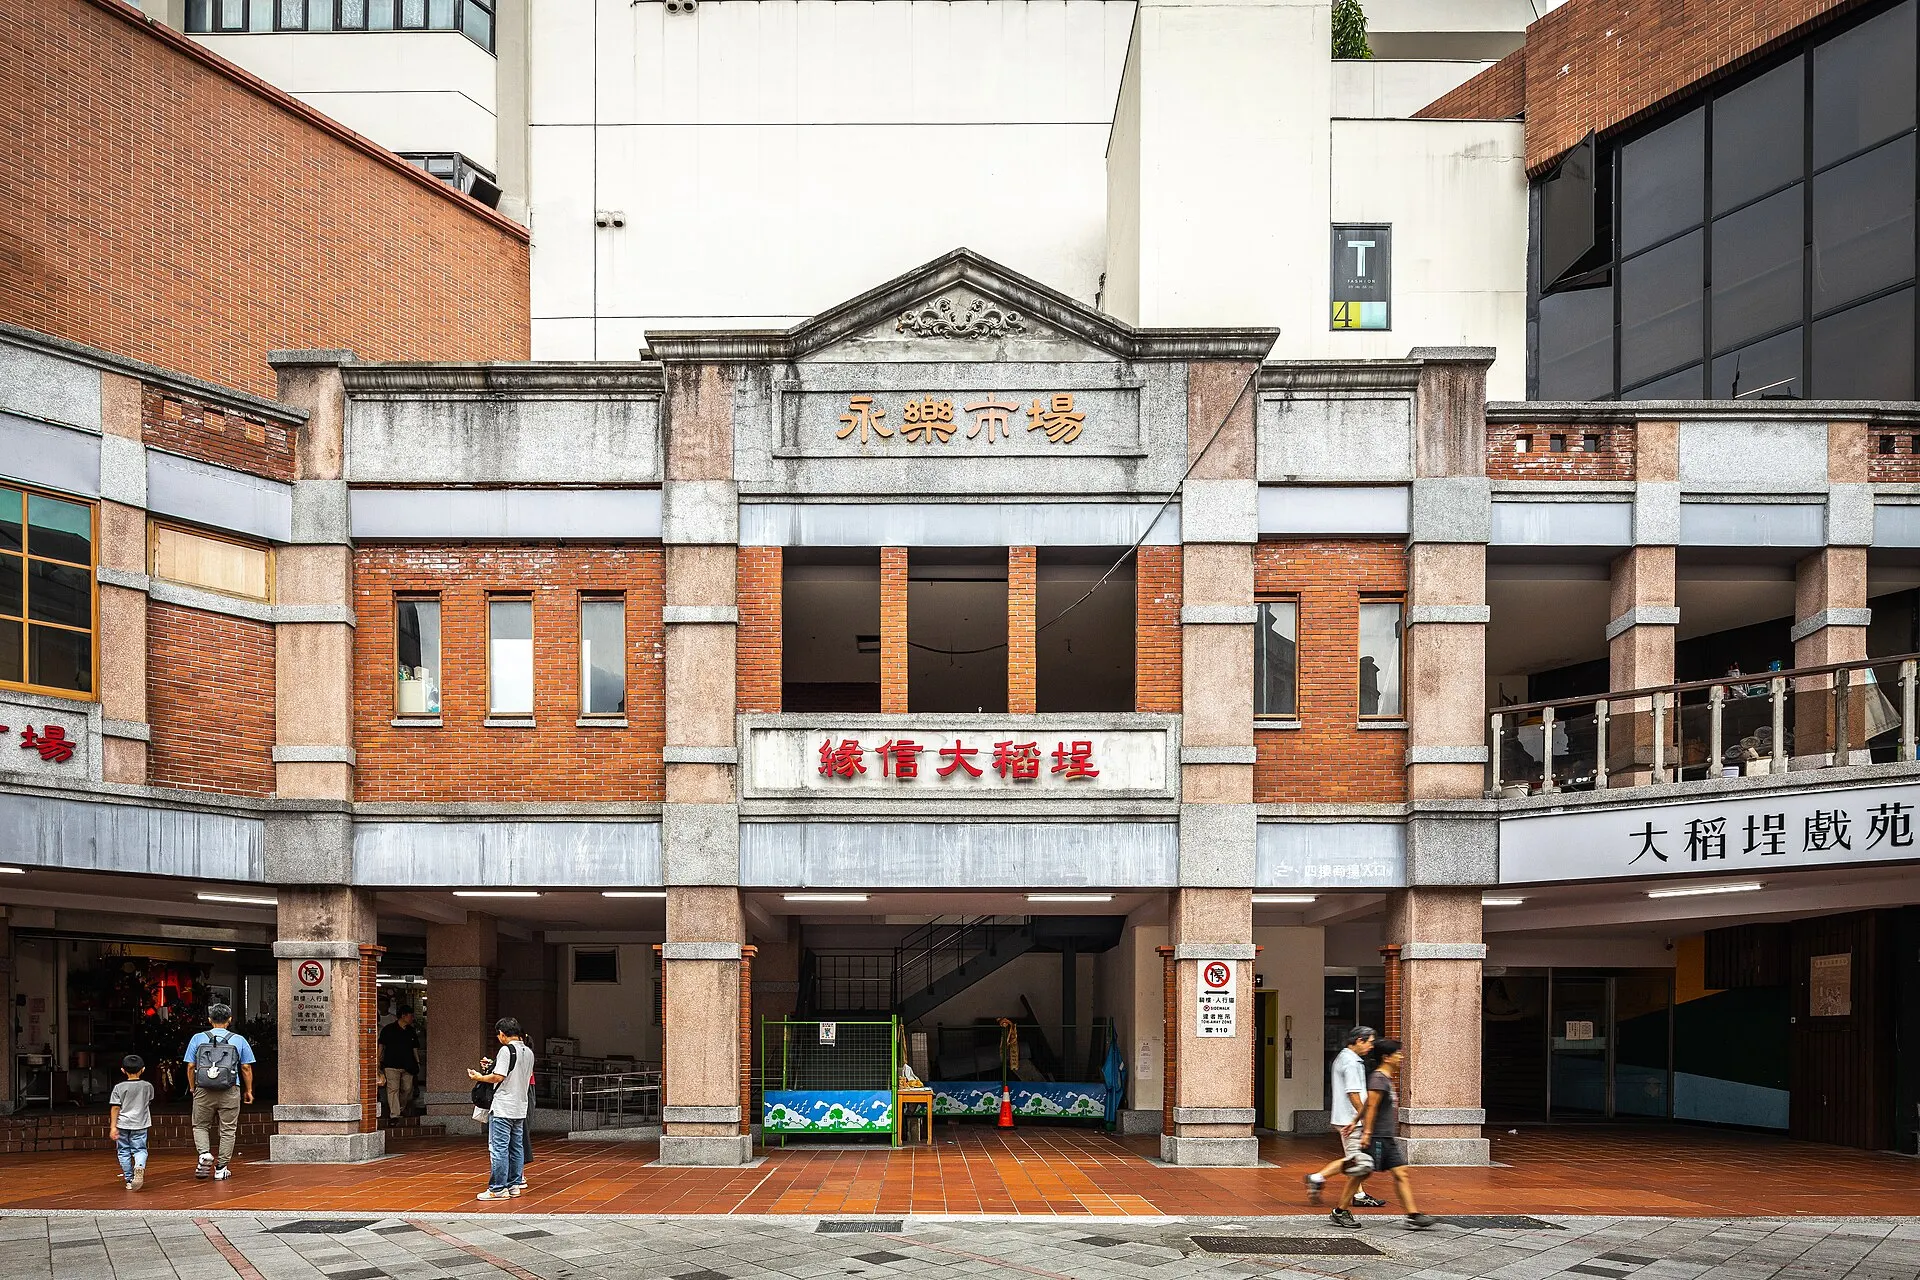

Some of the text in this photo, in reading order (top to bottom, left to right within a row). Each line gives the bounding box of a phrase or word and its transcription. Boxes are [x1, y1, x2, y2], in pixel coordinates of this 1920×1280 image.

[1347, 240, 1376, 277] T
[1333, 301, 1353, 328] 4
[836, 392, 1086, 444] 永樂市場
[0, 724, 77, 763] 場
[818, 739, 1100, 779] 緣信大稻埕
[1628, 802, 1915, 866] 大稻埕戲苑
